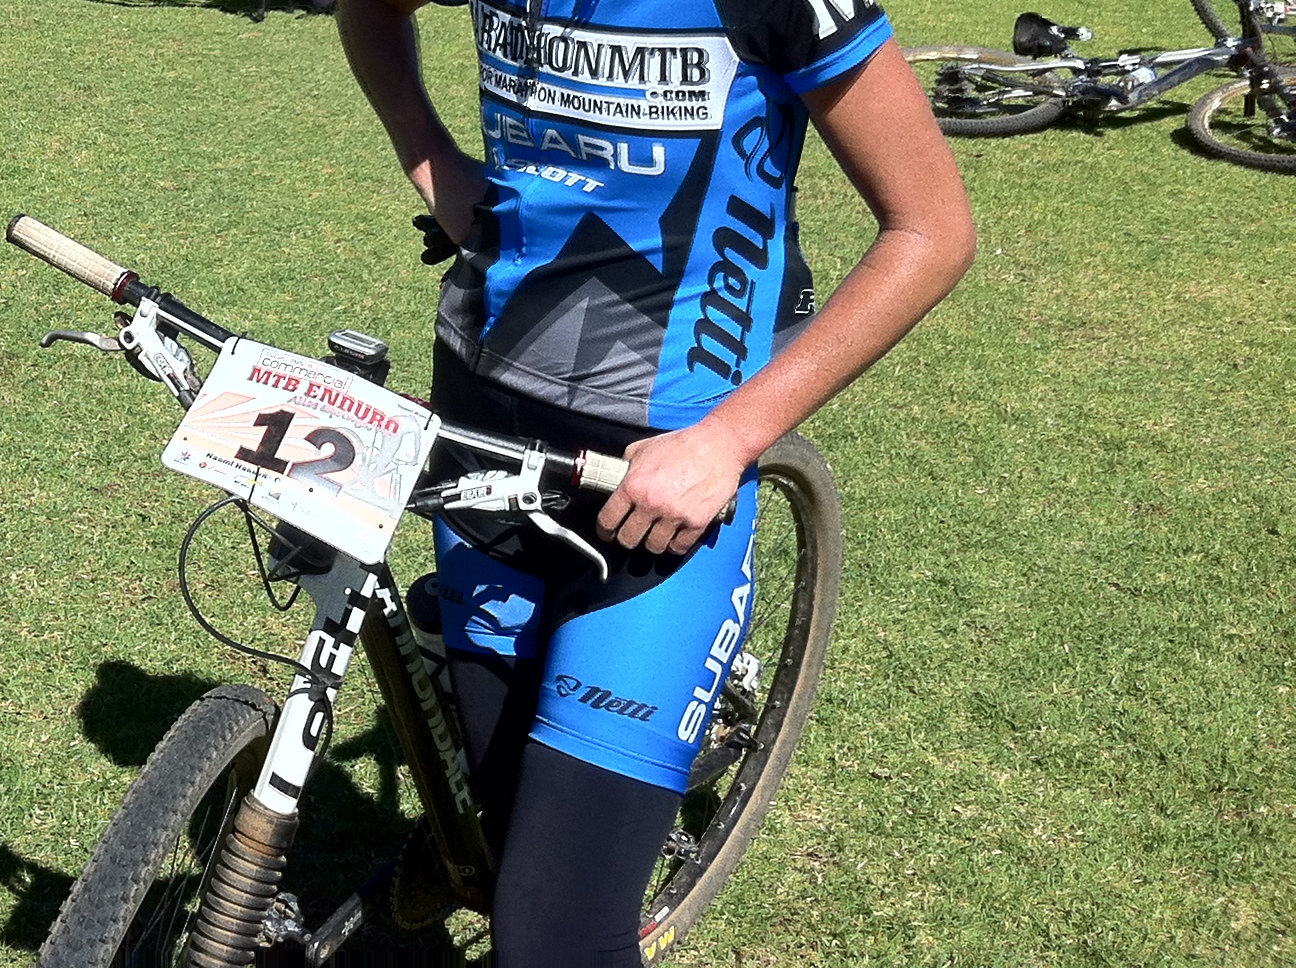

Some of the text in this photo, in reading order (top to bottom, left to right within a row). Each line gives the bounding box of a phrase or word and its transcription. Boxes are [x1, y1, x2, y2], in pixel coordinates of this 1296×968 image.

[686, 193, 776, 386] Netti
[247, 367, 301, 393] MTB
[304, 381, 401, 434] ENDURO
[234, 409, 356, 498] 12
[581, 684, 659, 723] Netti
